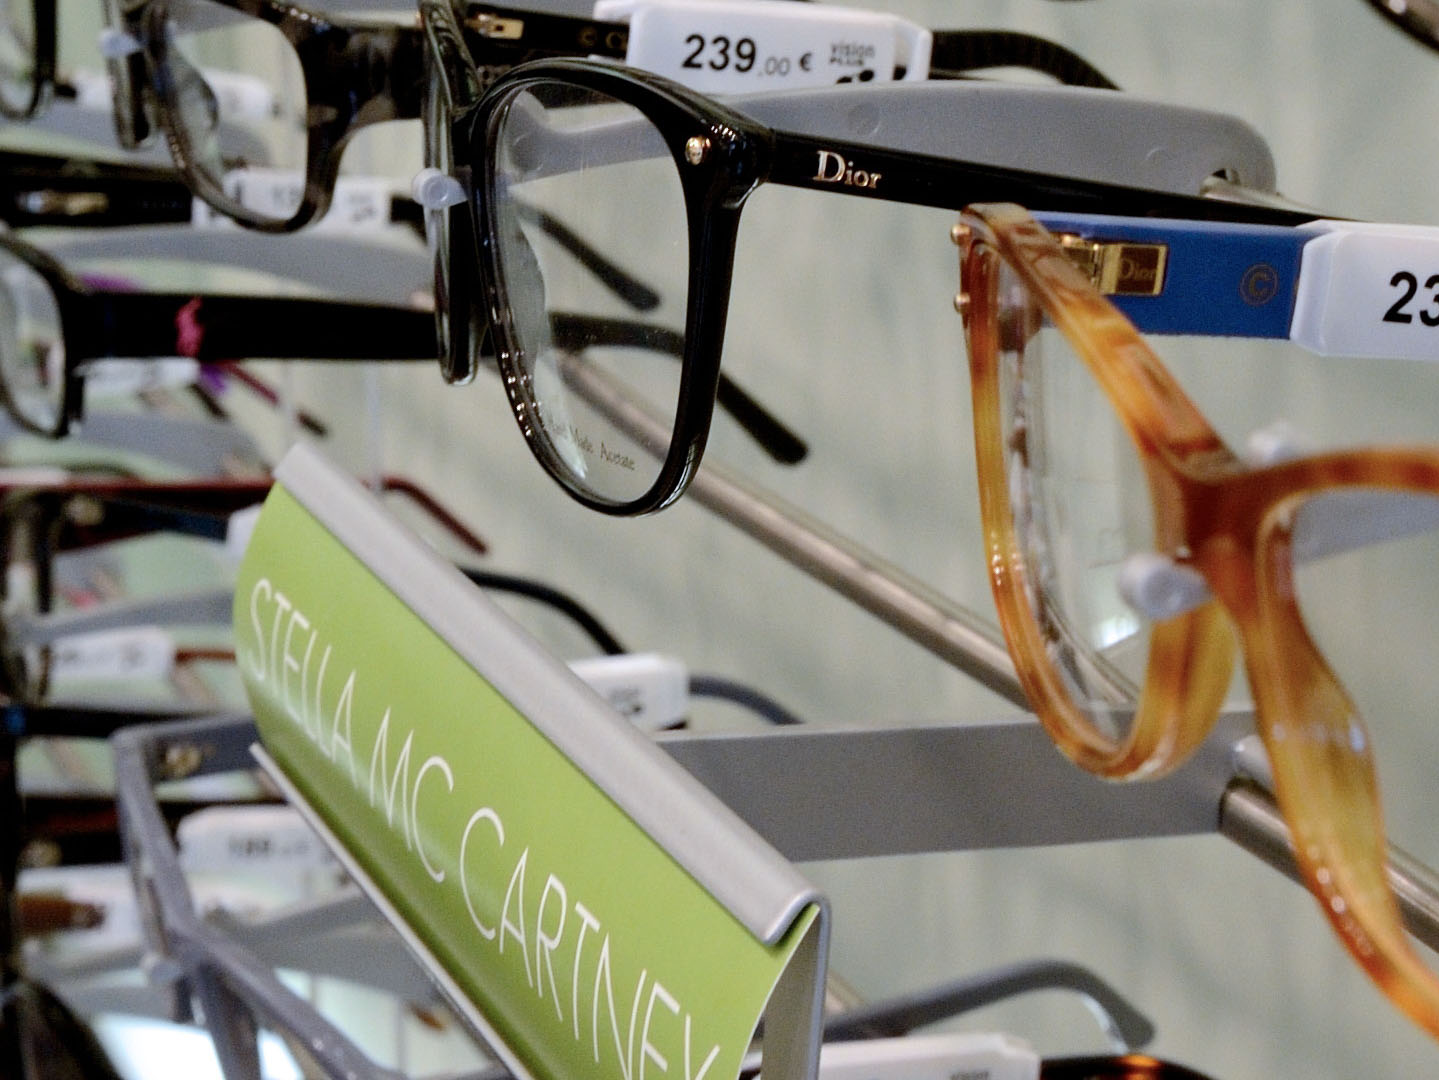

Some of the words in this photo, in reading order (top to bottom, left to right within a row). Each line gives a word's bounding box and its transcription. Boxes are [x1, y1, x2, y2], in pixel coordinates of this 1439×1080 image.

[812, 149, 883, 190] Dior
[250, 577, 358, 790] STELLA
[369, 705, 455, 884] MC
